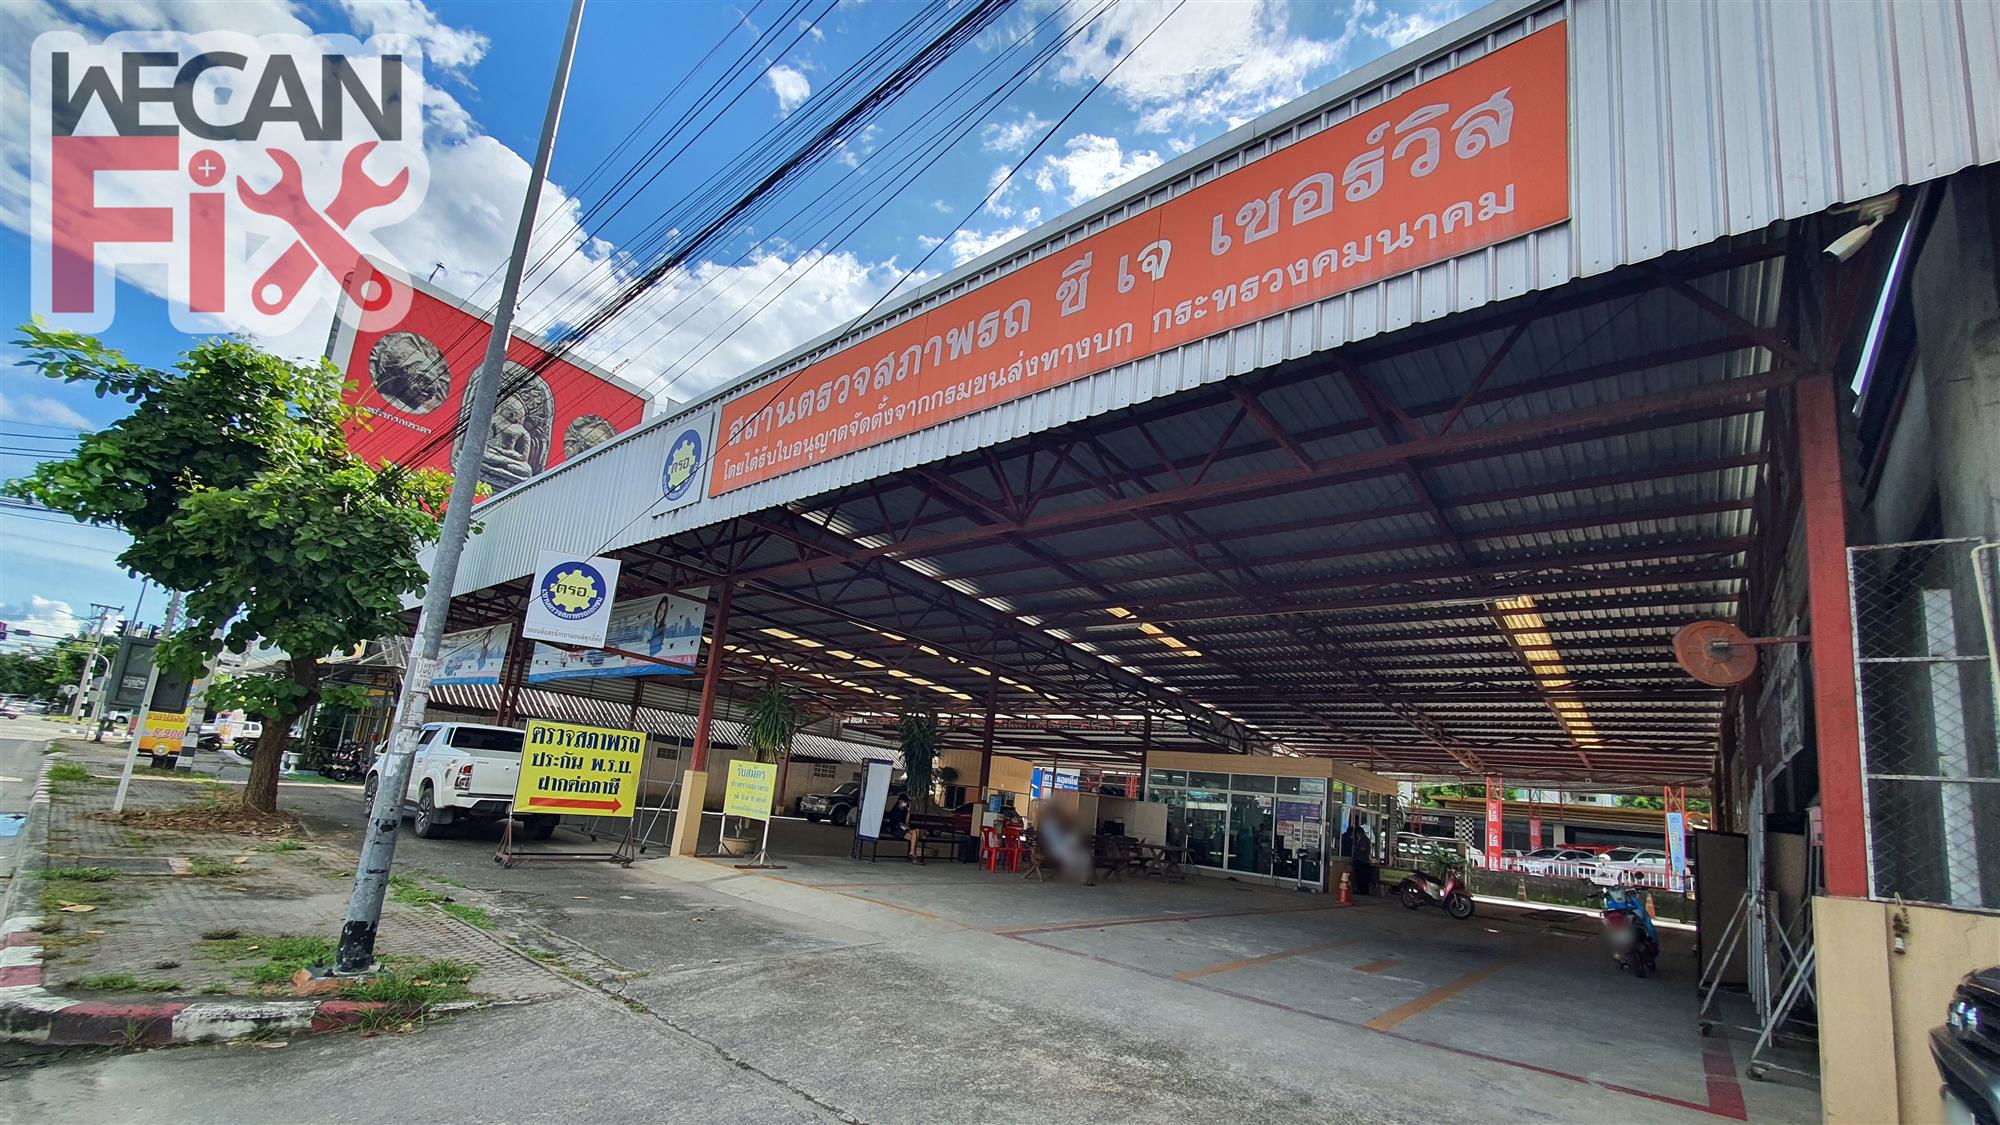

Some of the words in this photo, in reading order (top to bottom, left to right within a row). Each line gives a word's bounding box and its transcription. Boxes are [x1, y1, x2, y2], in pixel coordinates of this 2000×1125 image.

[728, 299, 1031, 447] สถานตรวจสภาพรถ
[1056, 251, 1092, 317] ซี
[1117, 239, 1172, 294] เจ
[1211, 87, 1514, 255] เซอร์วิส
[722, 322, 1133, 480] โดยได้รับใบอนุญาตจัดตั้งจากกรมขนส่งทางบก
[1153, 183, 1515, 333] กระทรวงคมนาคม
[556, 584, 590, 598] ตรอ.
[531, 726, 640, 753] ตรวจสภาพรถ
[532, 752, 584, 769] ประกัน
[591, 758, 632, 774] พ.ร.บ.
[538, 776, 621, 795] ฝากต่อภาษี
